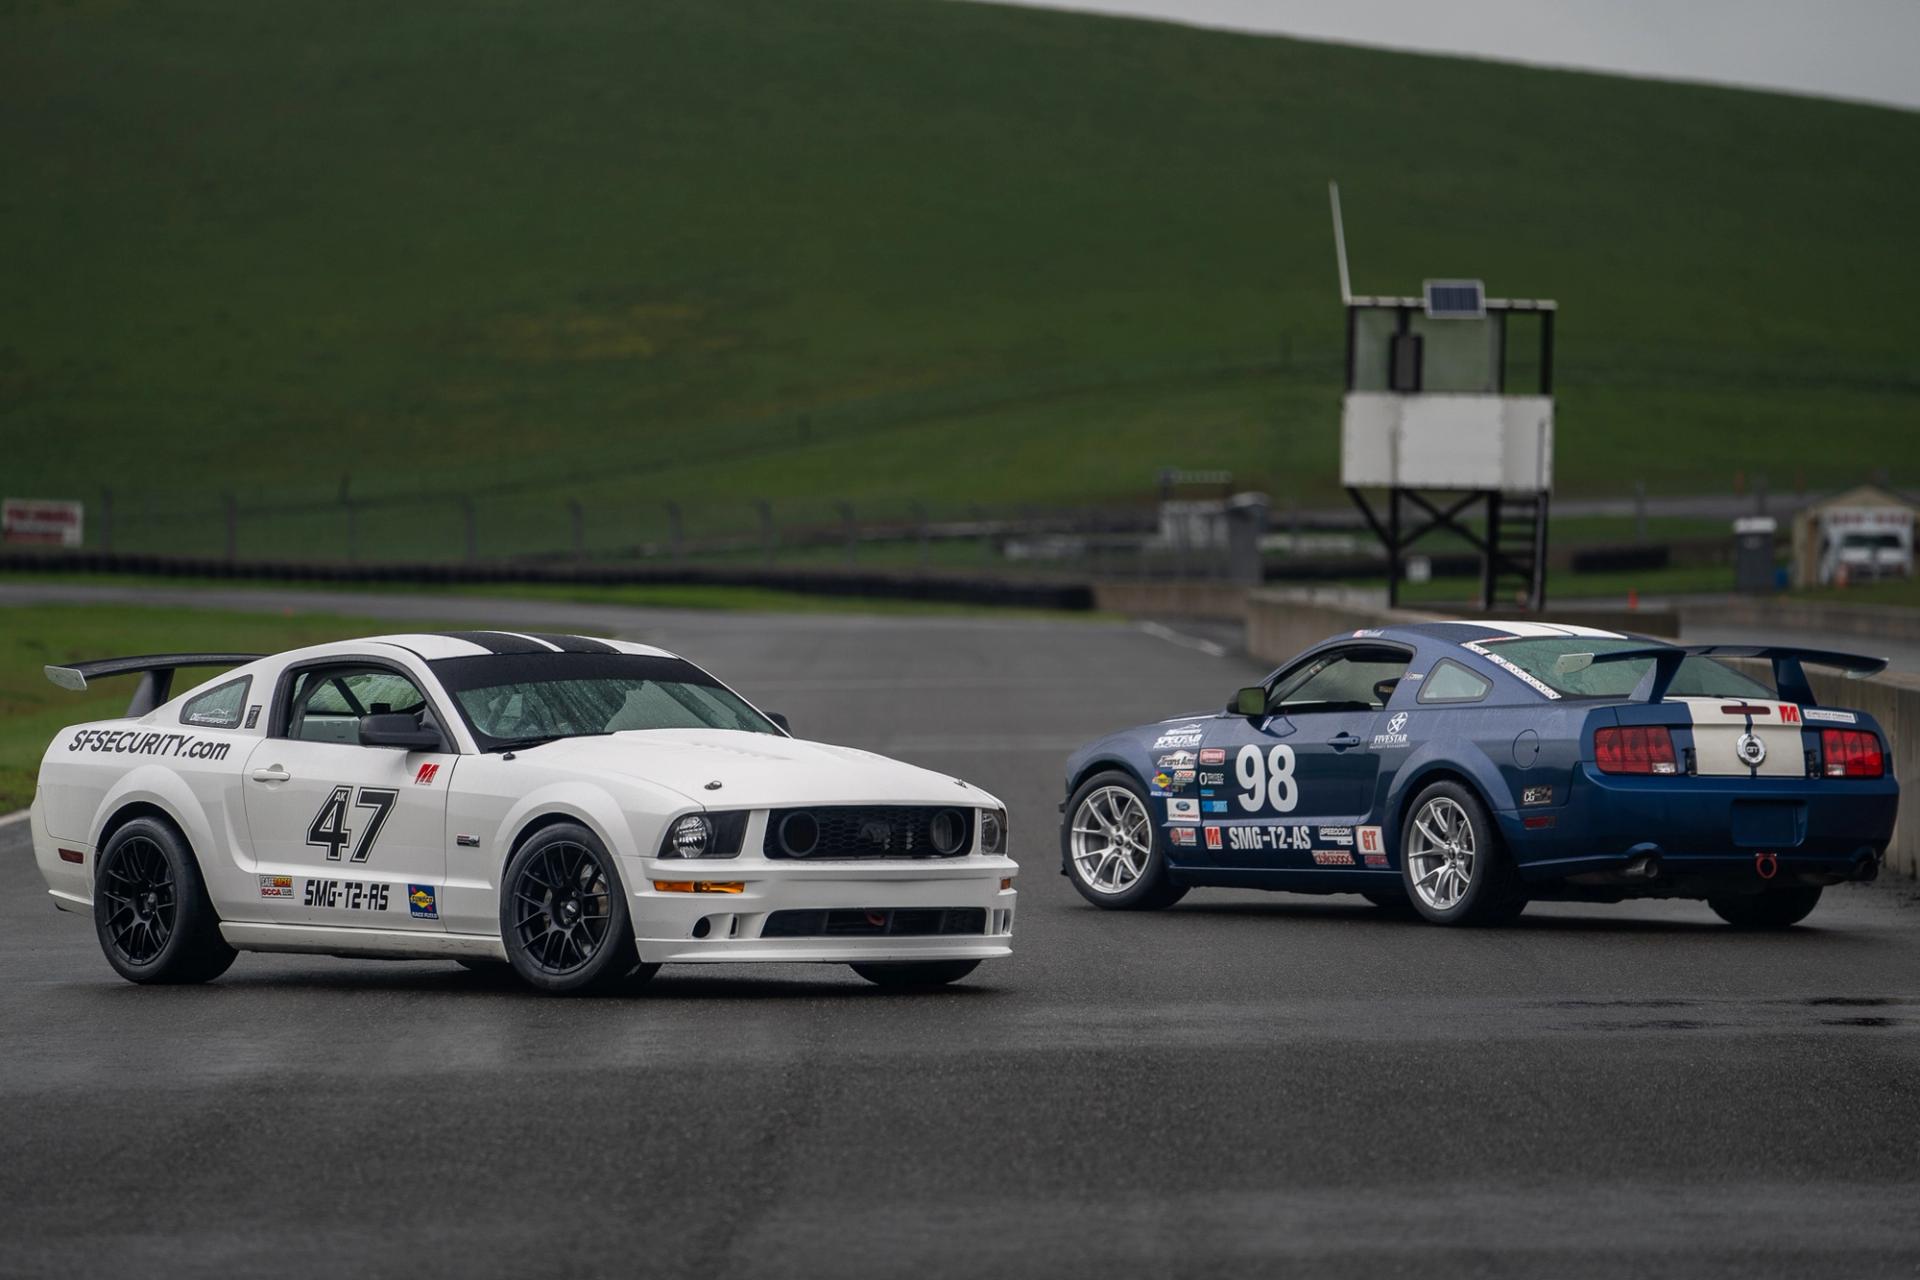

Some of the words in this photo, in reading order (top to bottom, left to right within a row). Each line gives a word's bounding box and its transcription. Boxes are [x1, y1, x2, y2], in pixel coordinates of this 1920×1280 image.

[68, 729, 232, 761] SFSECURITY.com
[1374, 733, 1408, 744] FIVESTAR
[1235, 744, 1298, 812] 98
[334, 791, 347, 802] AK
[306, 785, 400, 863] 47
[1320, 827, 1352, 836] SPEEDCOM
[1228, 825, 1312, 850] SMG-T2-AS
[1362, 830, 1377, 851] GT
[261, 888, 281, 896] SCCA
[304, 879, 390, 911] SMG-T2-AS
[410, 894, 434, 905] SUNOCO
